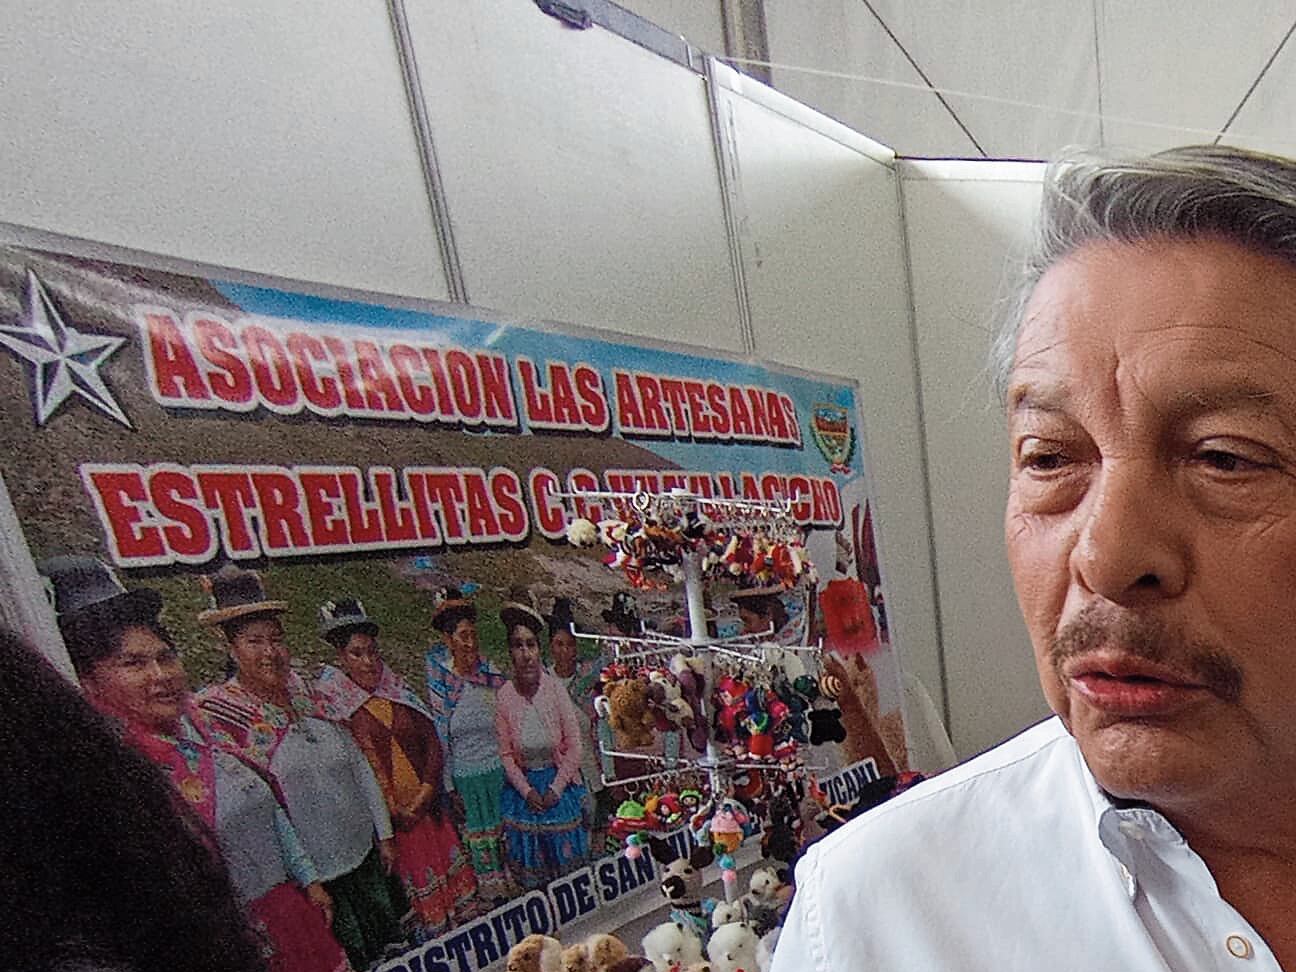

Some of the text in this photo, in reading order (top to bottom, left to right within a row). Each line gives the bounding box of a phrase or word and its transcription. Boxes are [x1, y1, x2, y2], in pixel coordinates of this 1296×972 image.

[146, 312, 800, 443] ASOCIACION LAS ARTESANAS
[90, 471, 524, 559] ESTRELLITAS
[551, 872, 597, 926] DE
[599, 846, 656, 902] SAN
